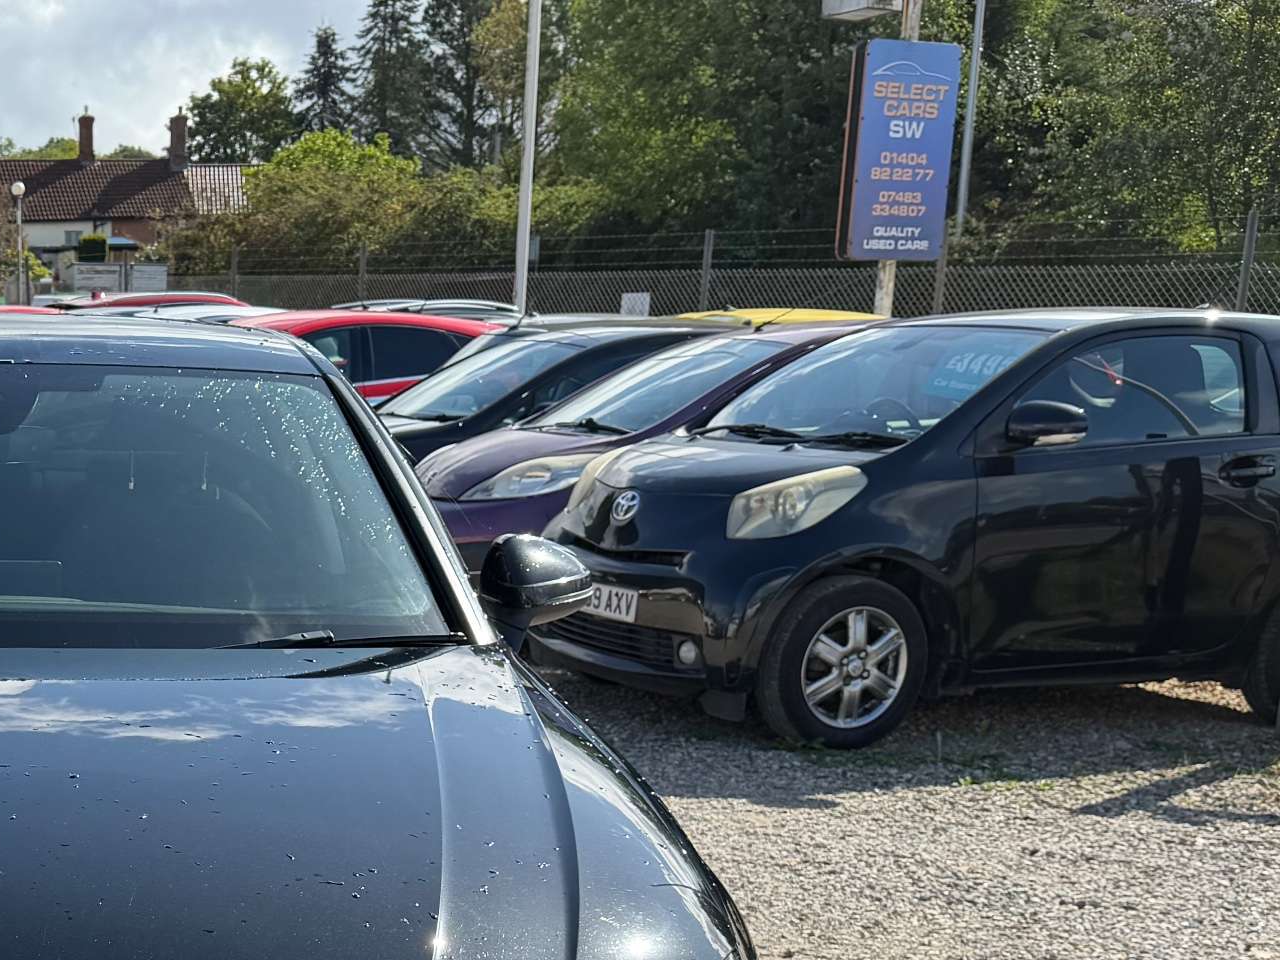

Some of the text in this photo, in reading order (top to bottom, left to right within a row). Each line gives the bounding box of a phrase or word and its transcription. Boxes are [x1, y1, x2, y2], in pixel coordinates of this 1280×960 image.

[873, 81, 950, 101] SELECT
[883, 100, 940, 119] CARS
[888, 120, 925, 139] SW
[880, 151, 928, 166] 01404
[878, 190, 922, 204] 07483
[871, 203, 927, 217] 334807
[872, 226, 922, 238] QUALITY
[863, 239, 929, 252] USED CARS
[604, 589, 634, 617] AXV
